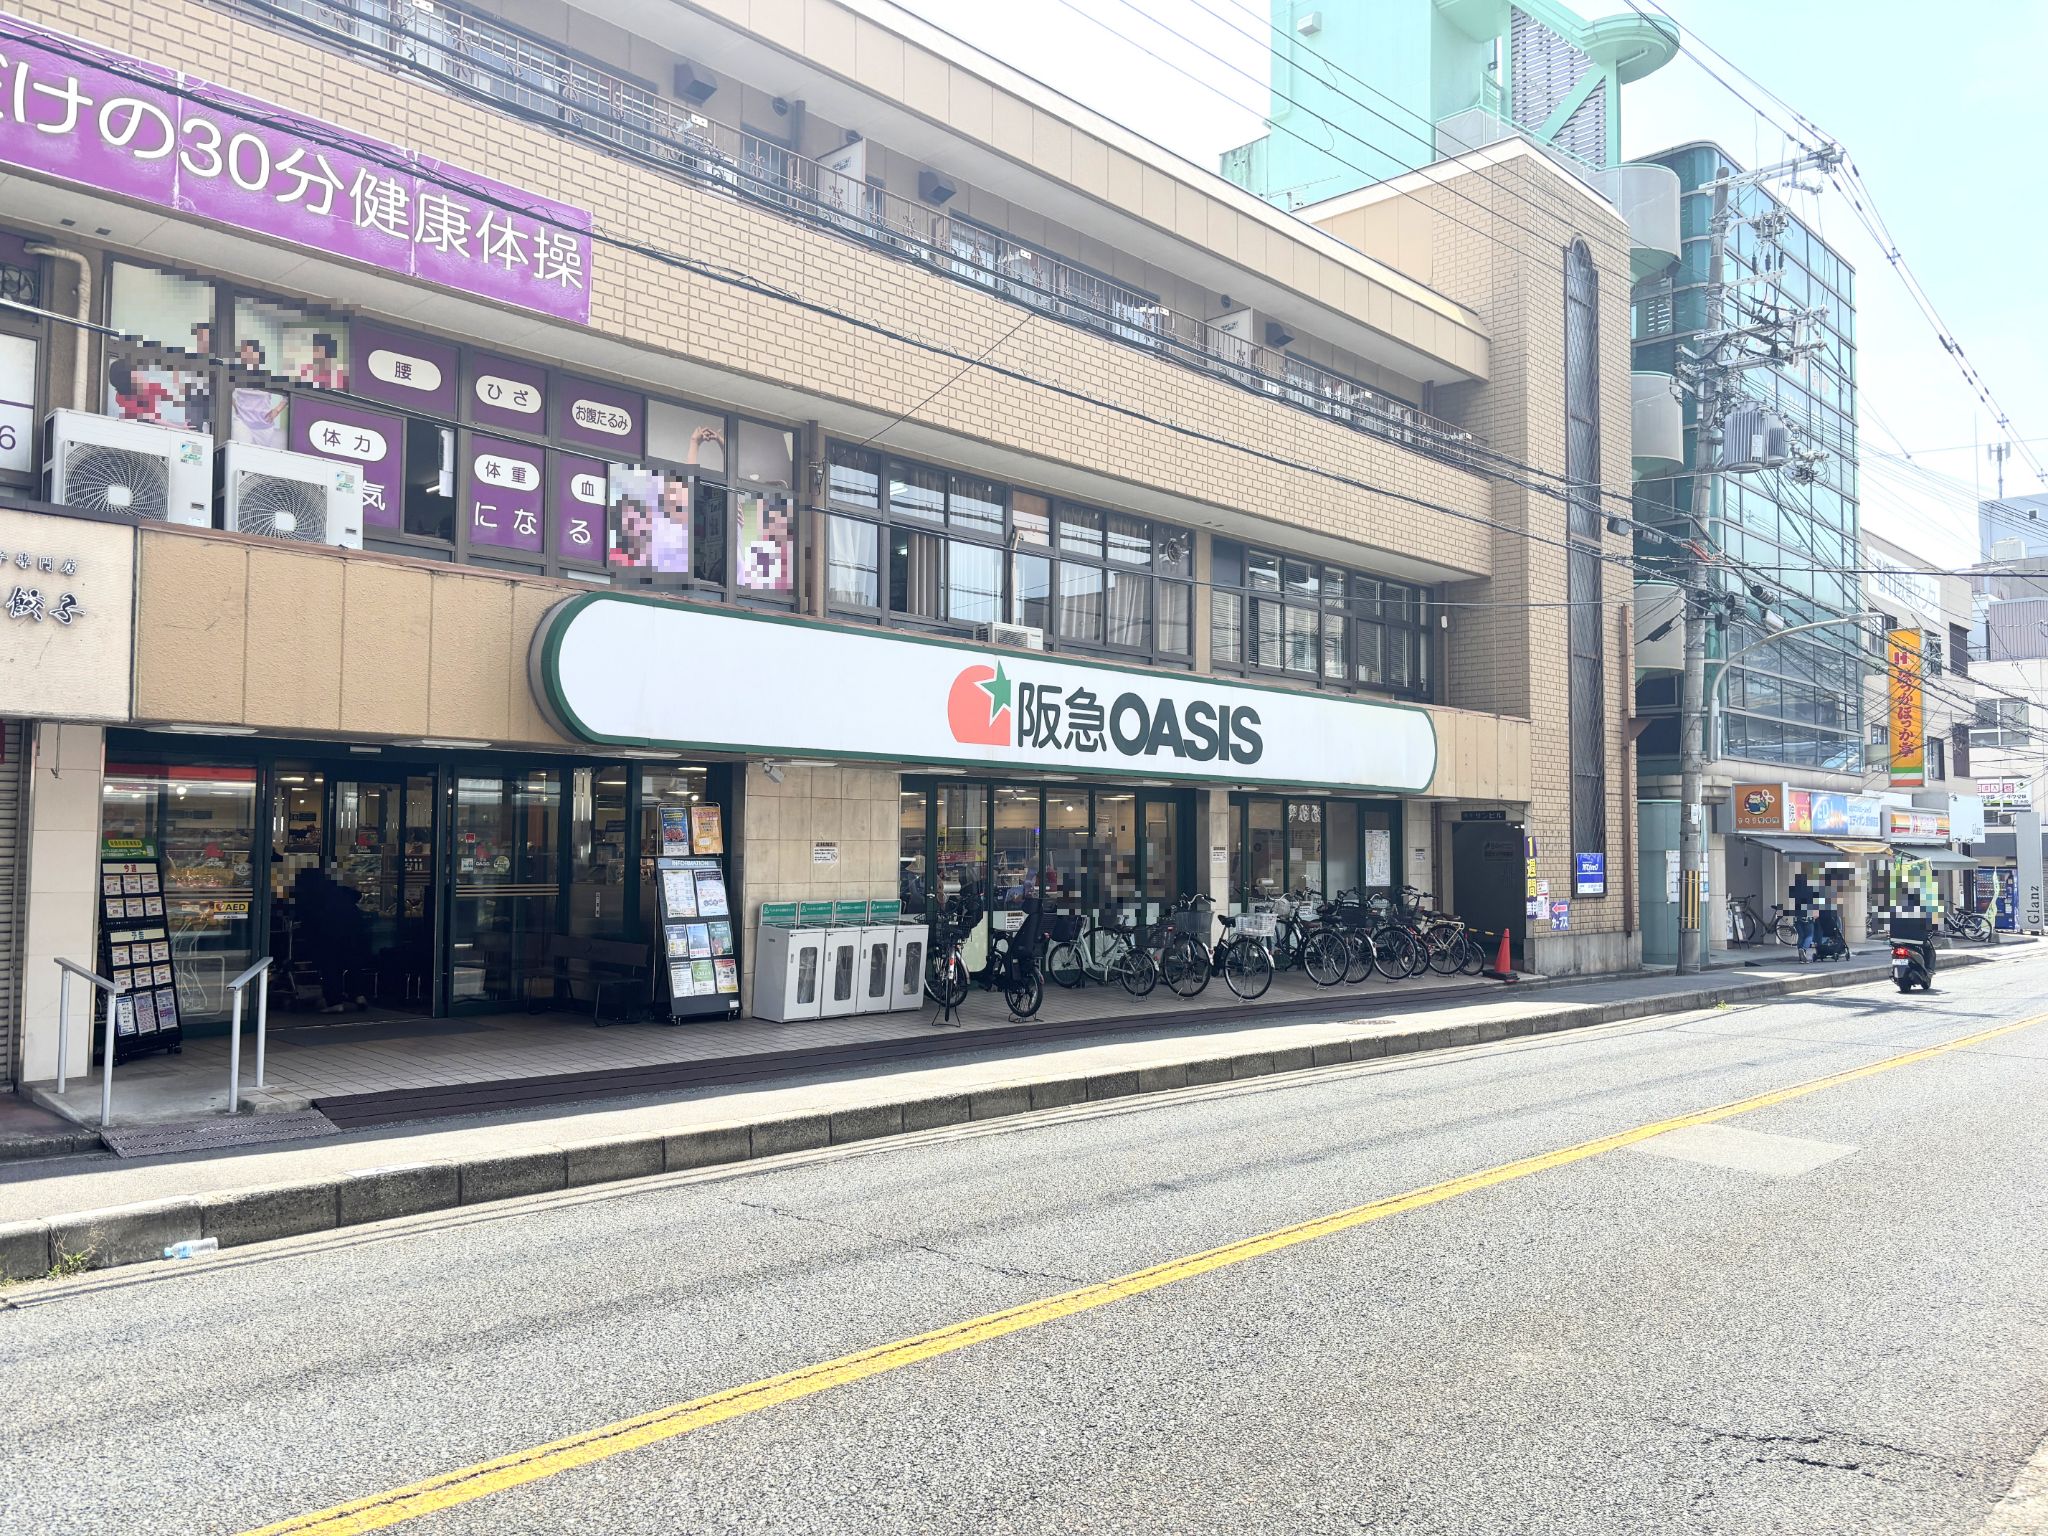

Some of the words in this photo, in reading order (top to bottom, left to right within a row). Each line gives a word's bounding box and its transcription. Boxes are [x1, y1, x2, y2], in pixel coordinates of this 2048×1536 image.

[0, 54, 583, 289] けの30分健康体操
[394, 361, 413, 381] 腰
[487, 383, 529, 407] ひざ
[575, 405, 628, 431] お腹たるみ
[322, 427, 372, 454] 体力
[485, 461, 527, 484] 体重
[363, 480, 386, 511] 気
[6, 586, 87, 625] 餃子
[225, 903, 246, 911] AED
[2027, 886, 2040, 924] Glanz
